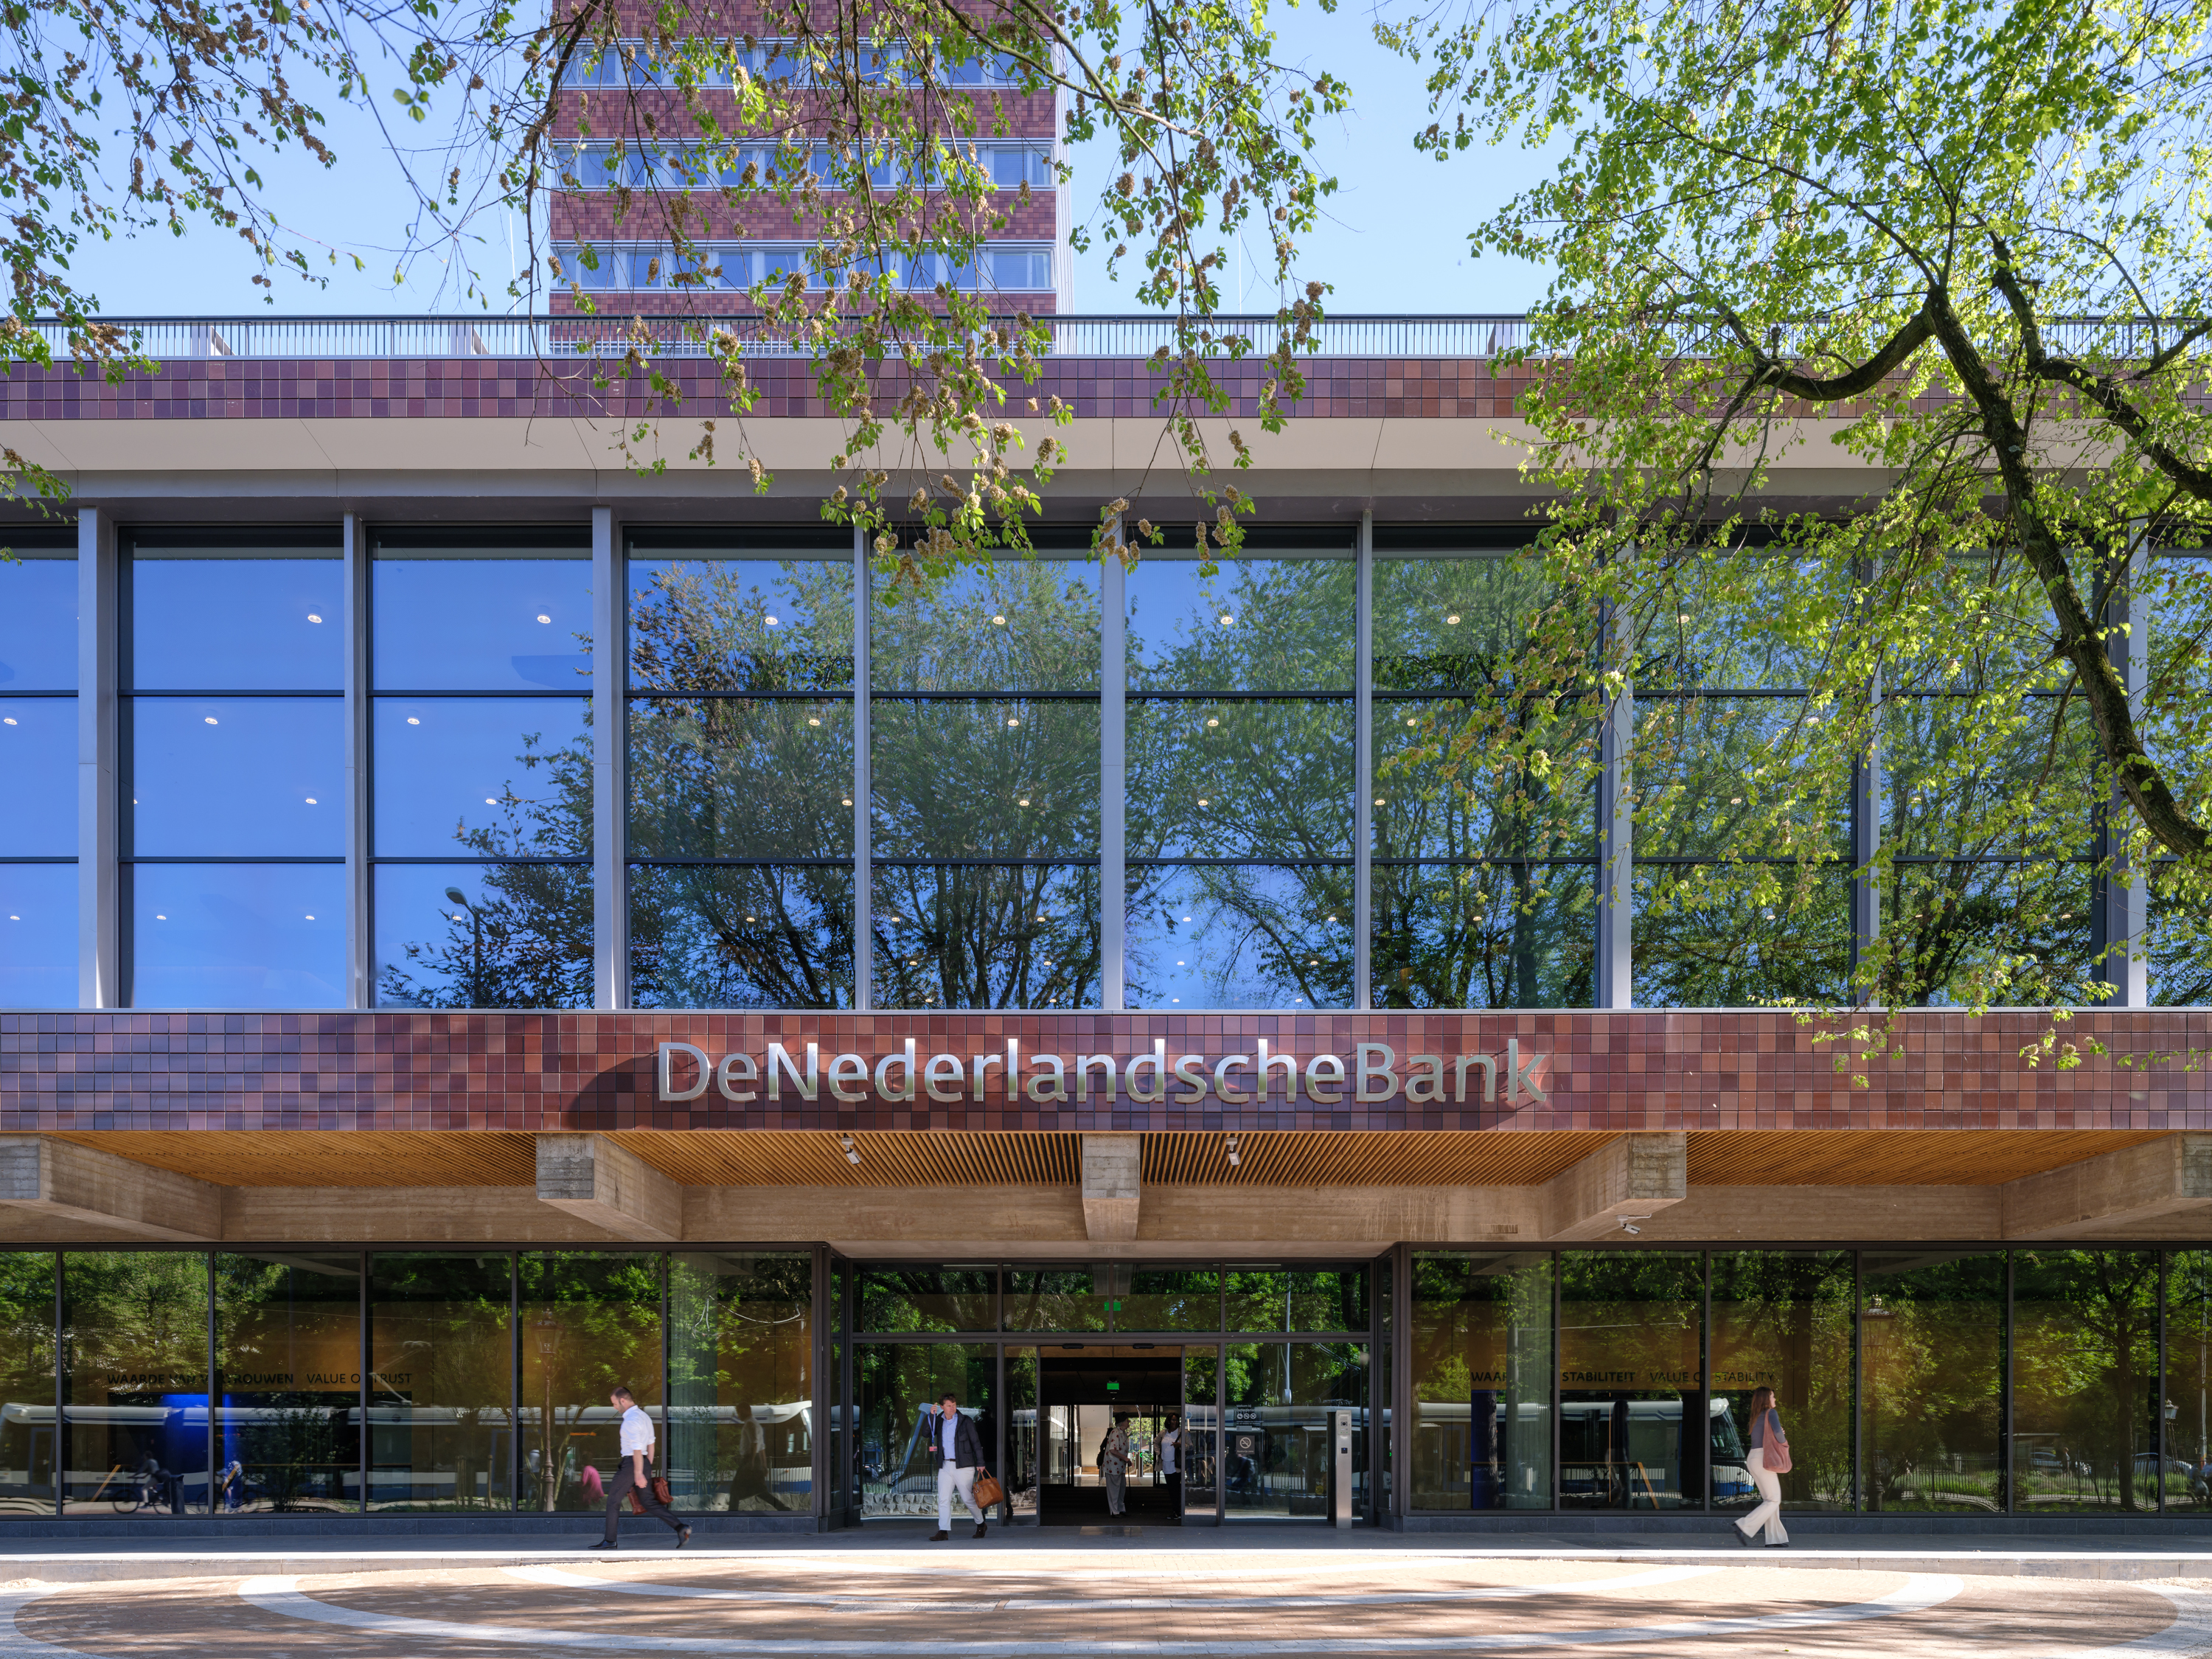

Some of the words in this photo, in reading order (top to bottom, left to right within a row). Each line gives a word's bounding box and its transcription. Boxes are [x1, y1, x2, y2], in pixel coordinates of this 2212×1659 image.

[658, 1038, 1548, 1102] DeNederlandscheBank
[107, 1374, 165, 1384] WAARDE
[169, 1374, 195, 1384] VAN
[306, 1373, 347, 1384] VALUE
[372, 1373, 413, 1384] TRUST
[1562, 1371, 1636, 1382] STABILITEIT
[1649, 1371, 1689, 1382] VALUE
[1714, 1371, 1775, 1382] STABILITY
